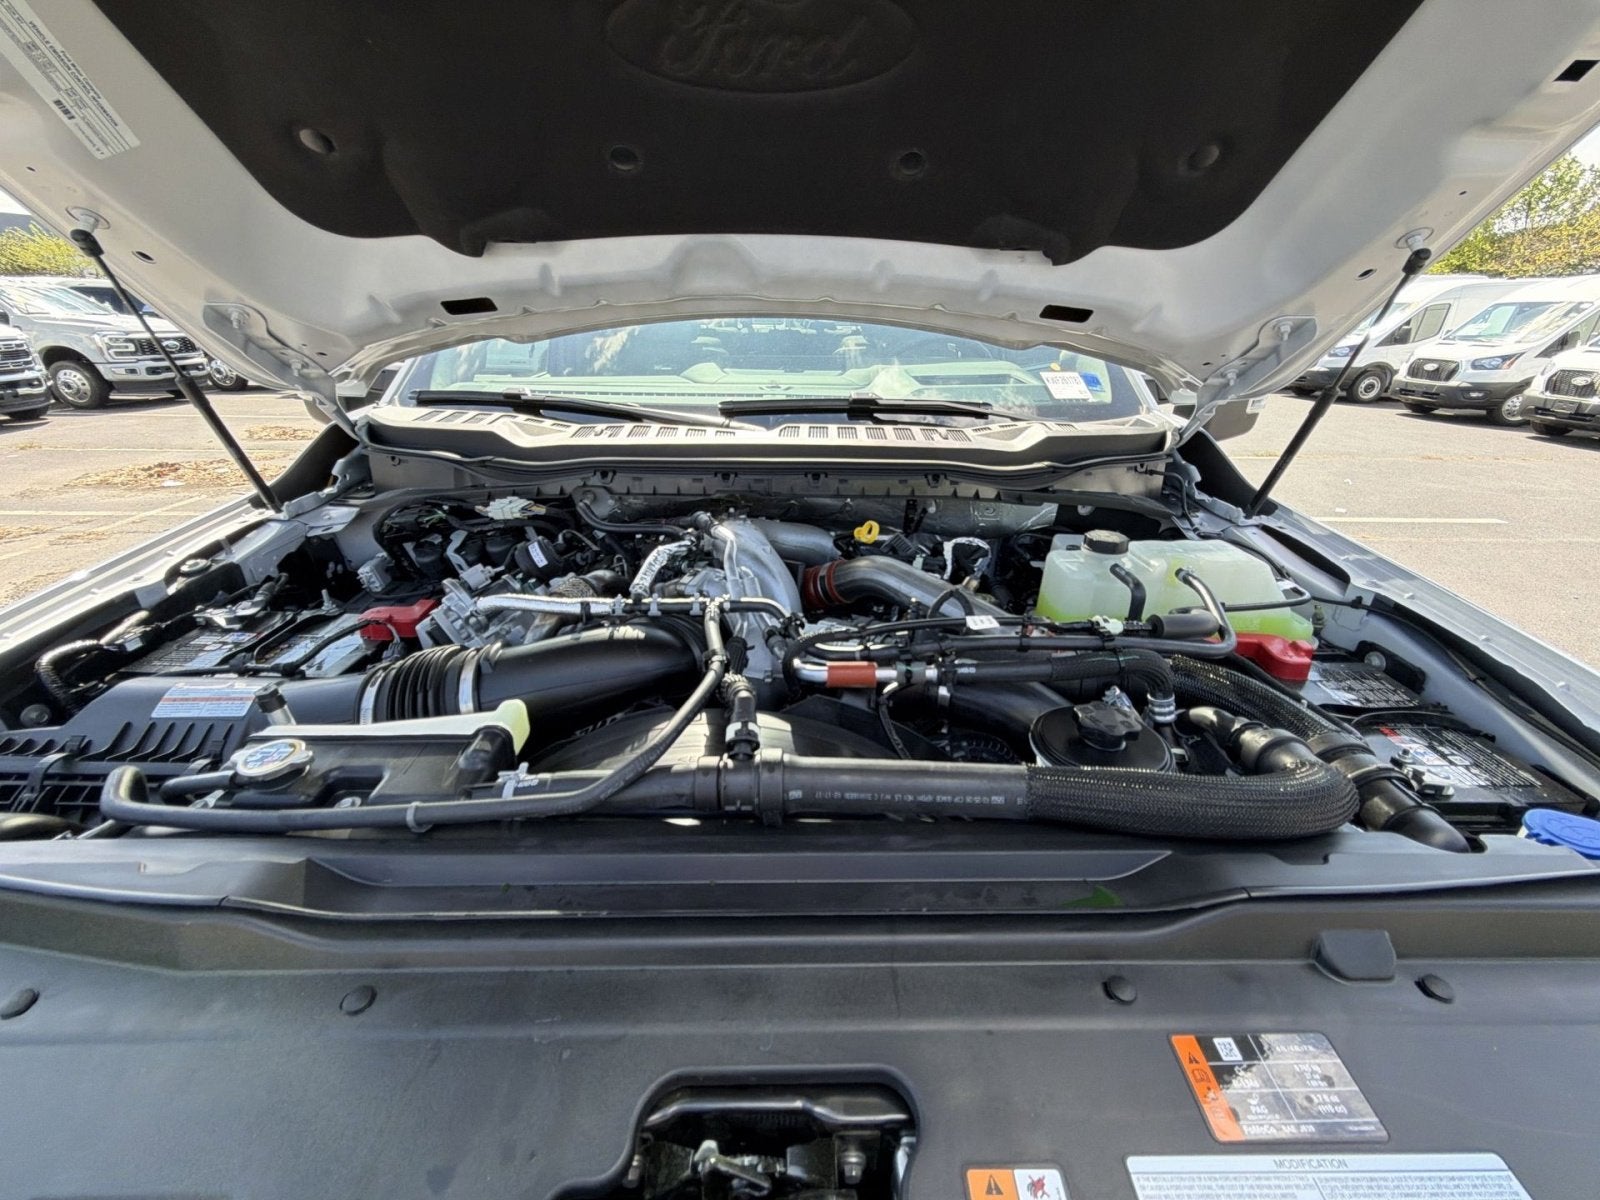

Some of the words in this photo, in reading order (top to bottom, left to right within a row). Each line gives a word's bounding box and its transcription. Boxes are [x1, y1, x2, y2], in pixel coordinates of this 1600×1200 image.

[660, 0, 868, 78] Ford
[29, 21, 50, 44] VEHICLE
[70, 71, 91, 94] CONTROL
[91, 95, 118, 127] INFORMATION
[60, 50, 72, 63] Ford
[70, 62, 84, 77] Motor
[82, 77, 102, 99] Company
[1273, 1158, 1349, 1170] MODIFICATION
